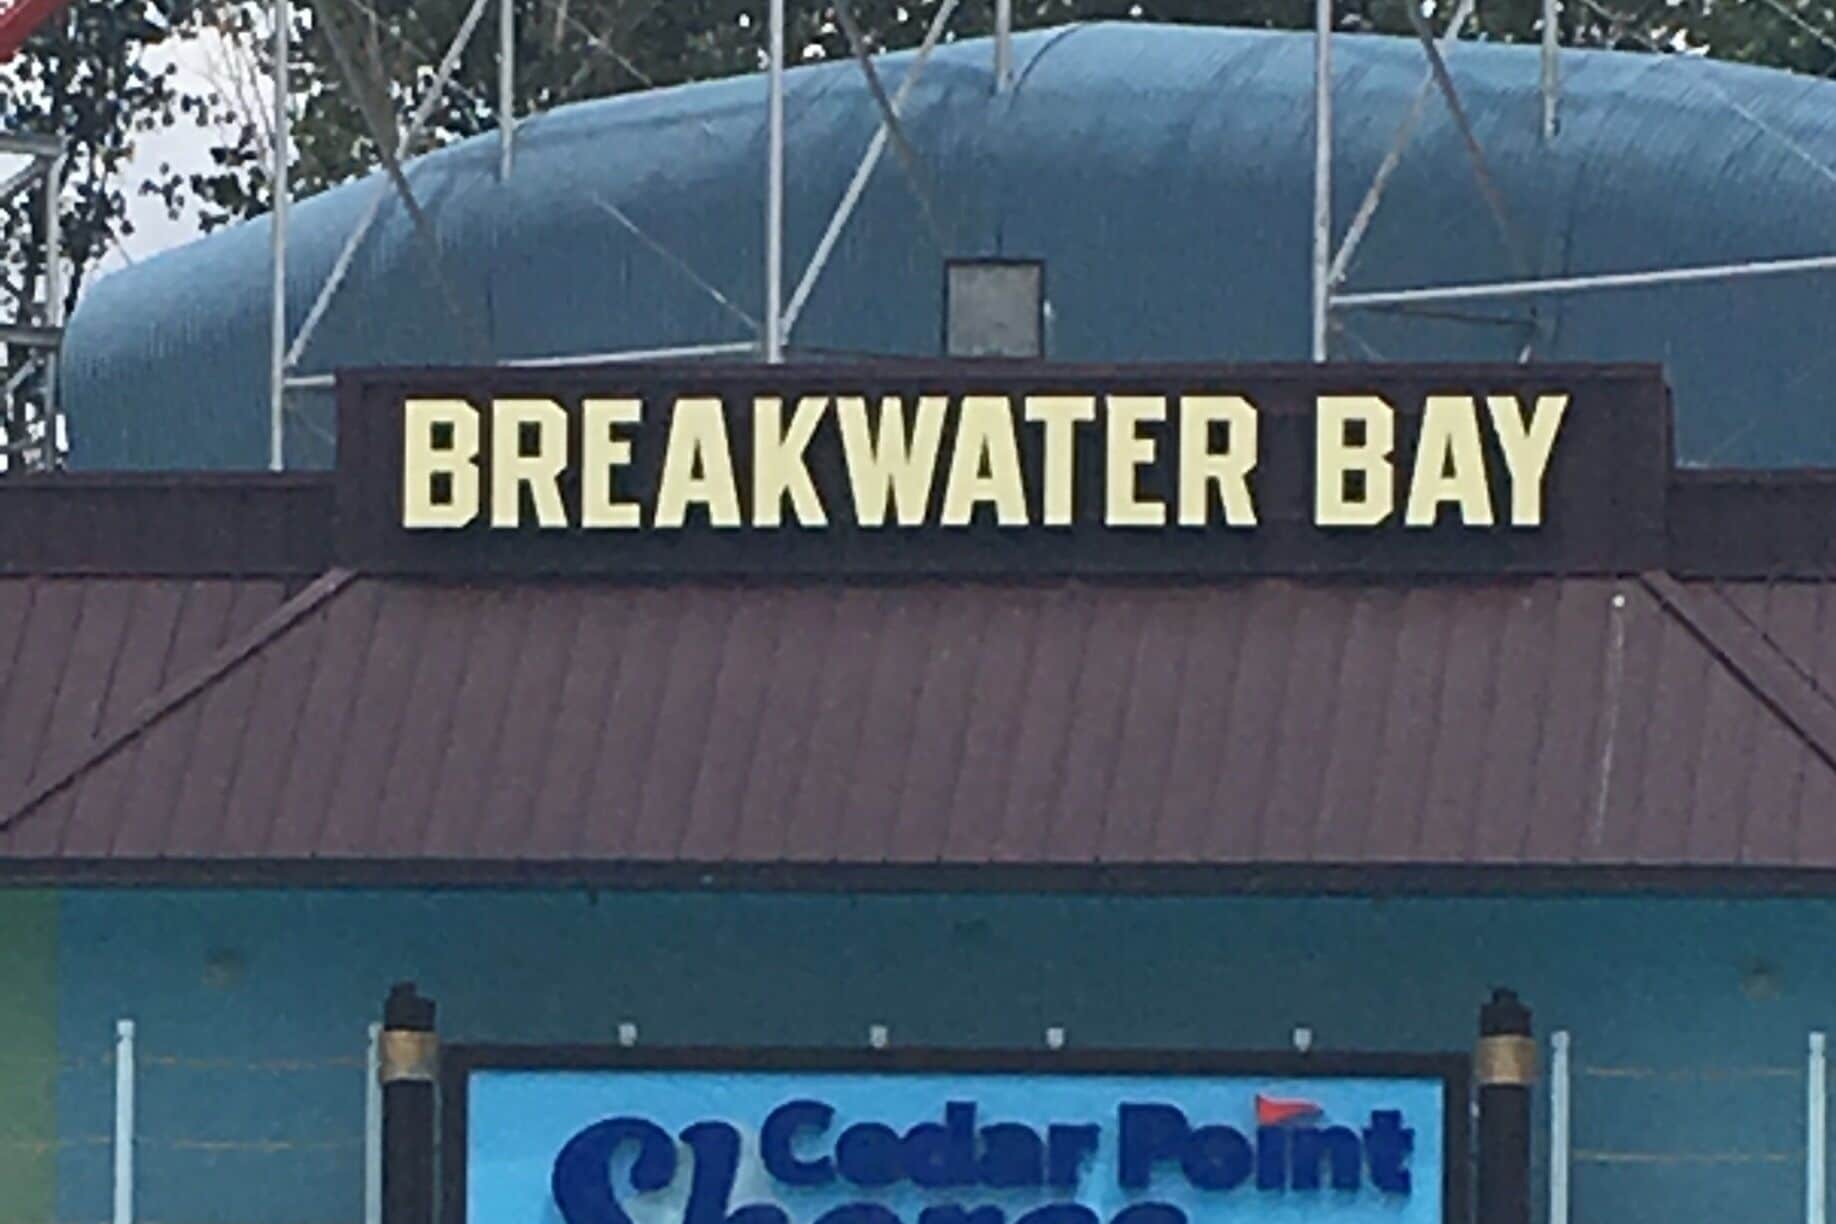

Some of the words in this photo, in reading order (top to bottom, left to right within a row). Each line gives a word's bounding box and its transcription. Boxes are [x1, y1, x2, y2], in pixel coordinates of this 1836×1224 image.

[403, 395, 1258, 528] BREAKWATER
[1315, 394, 1568, 527] BAY
[1117, 1095, 1416, 1198] Point
